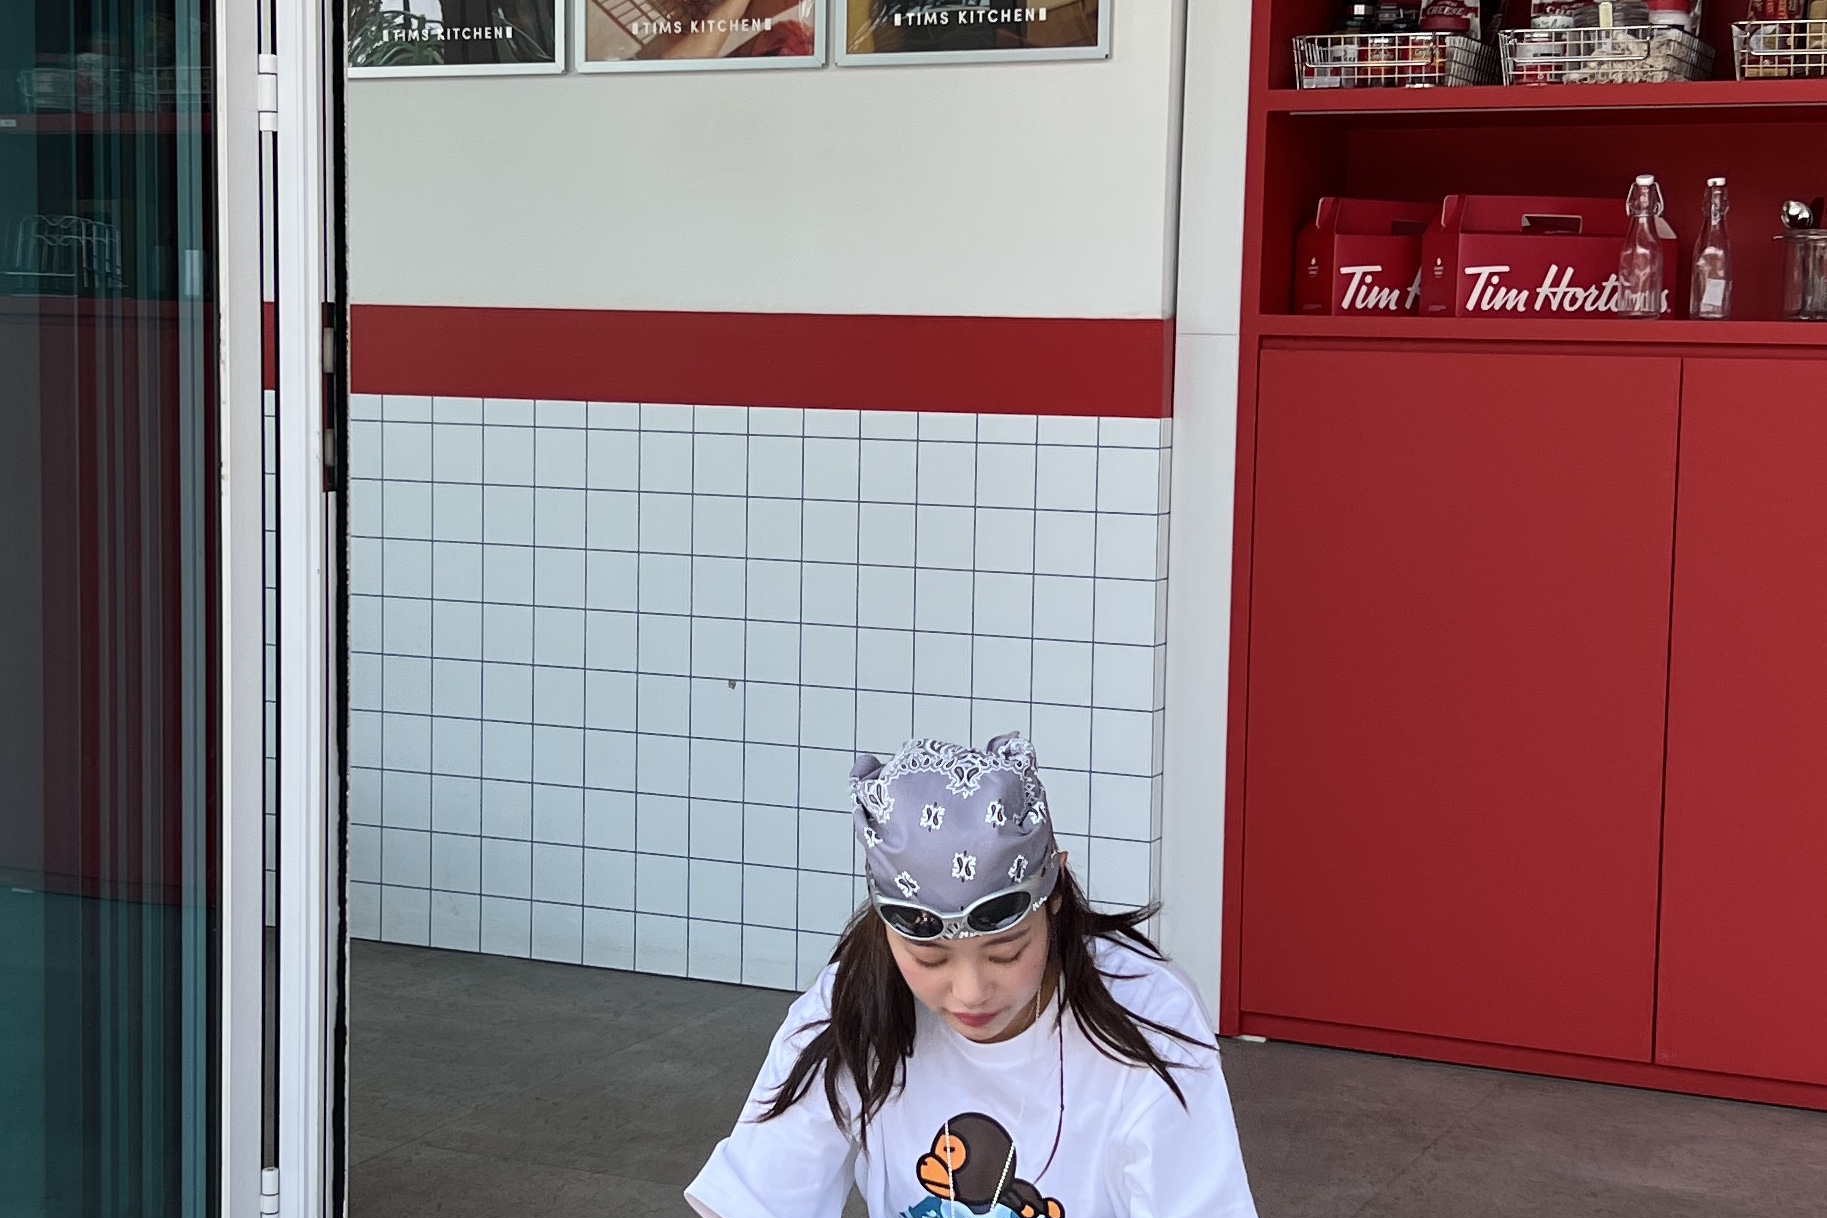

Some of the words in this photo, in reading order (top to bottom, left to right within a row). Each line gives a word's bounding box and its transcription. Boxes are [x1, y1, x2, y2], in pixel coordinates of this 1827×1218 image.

[642, 21, 682, 35] TIMS
[690, 17, 761, 33] KITCHEN
[904, 12, 949, 27] TIMS
[957, 8, 1036, 25] KITCHEN
[393, 28, 430, 42] TIMS
[437, 25, 503, 40] KITCHEN
[1339, 265, 1400, 311] Tim
[1464, 265, 1530, 312] Tim
